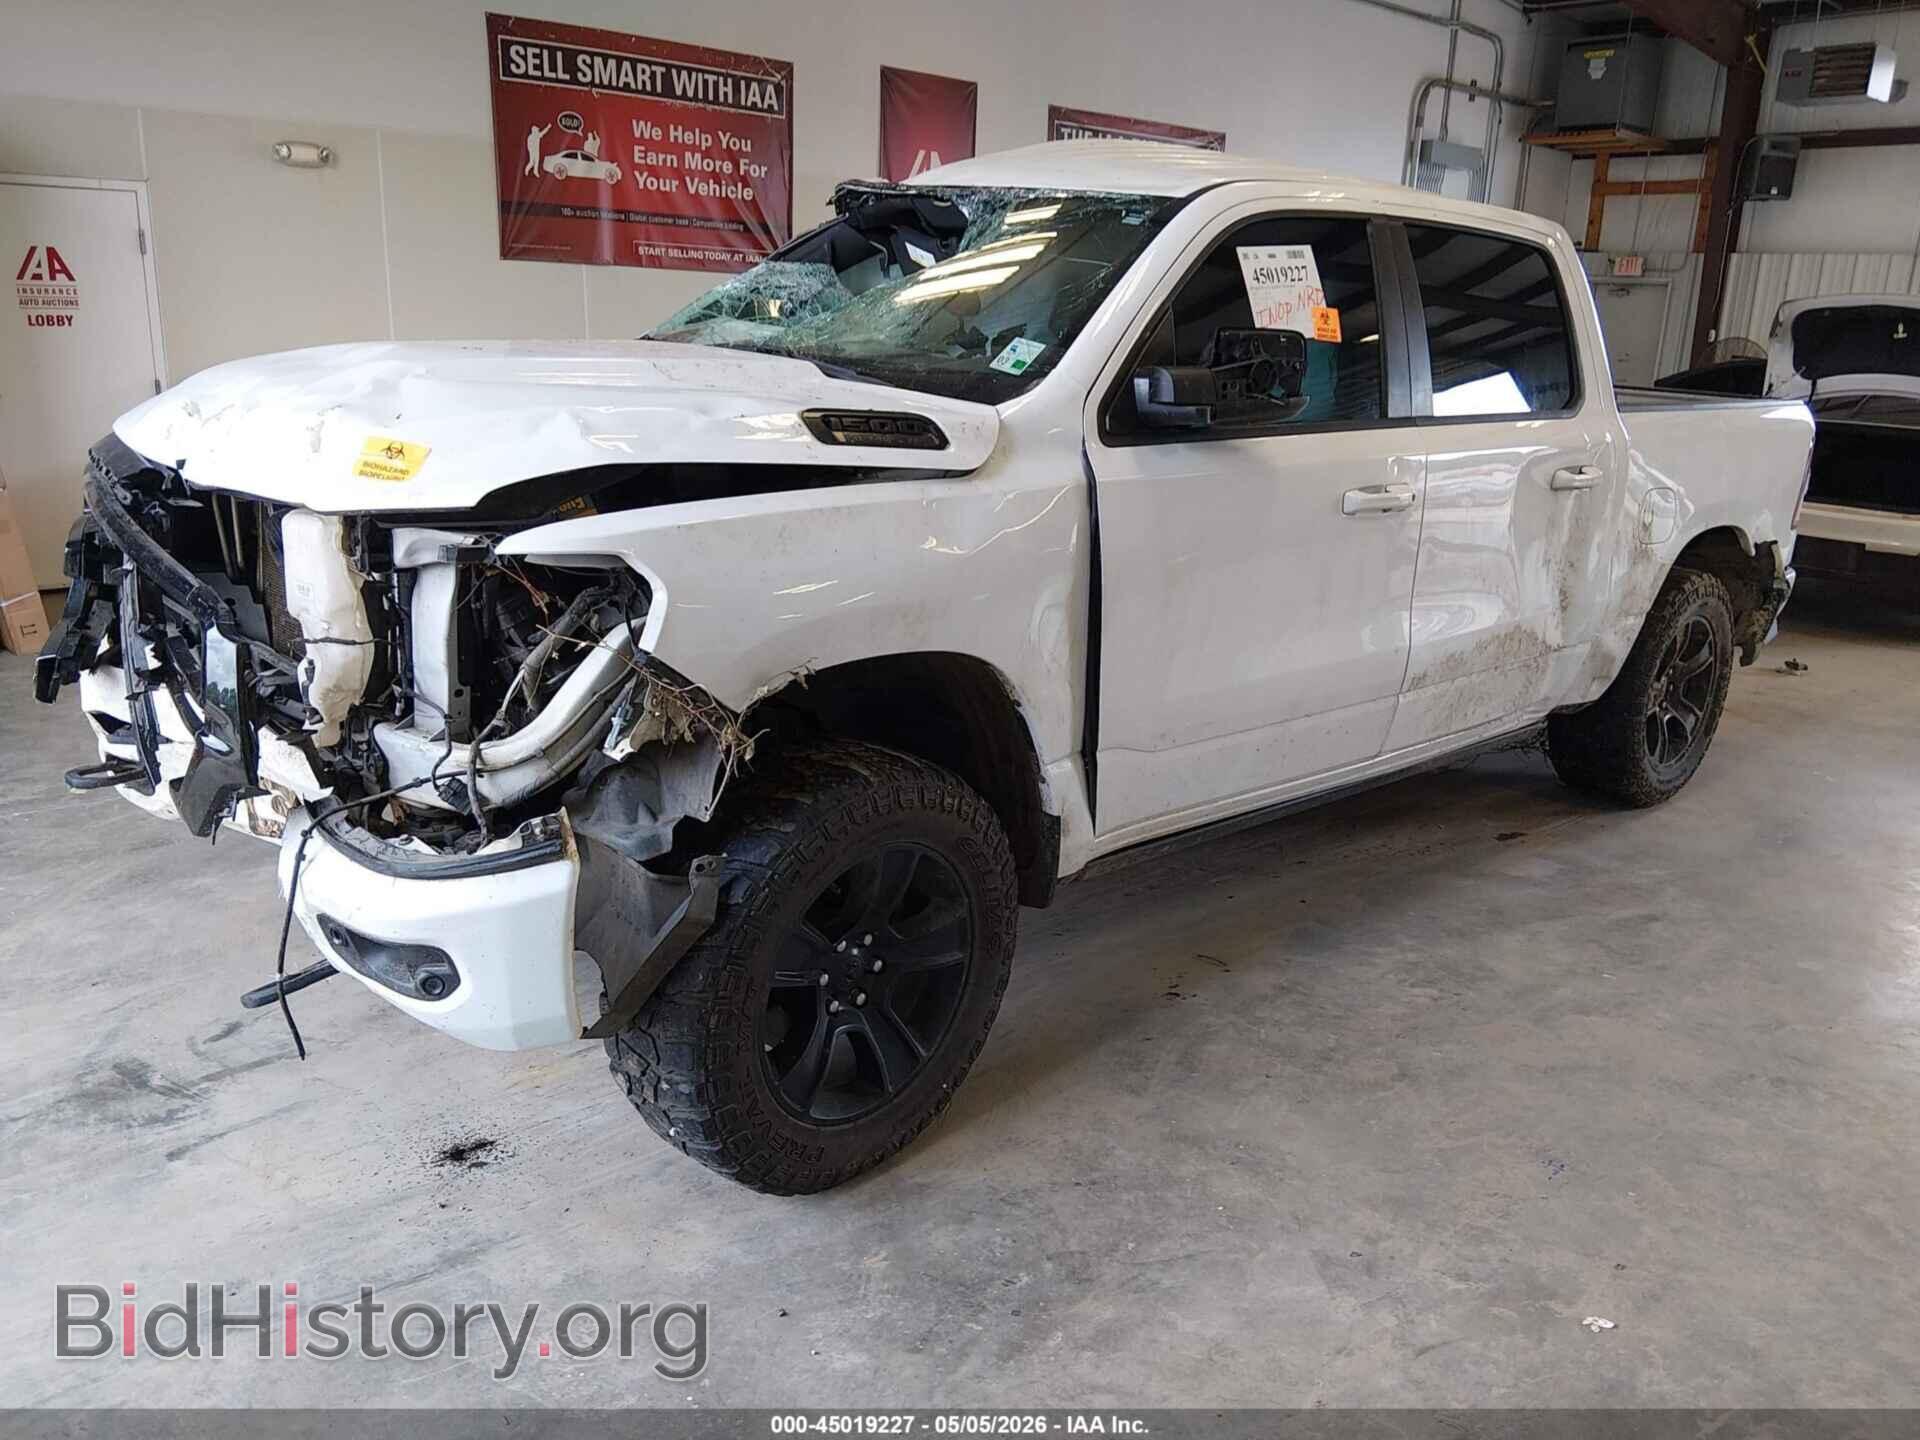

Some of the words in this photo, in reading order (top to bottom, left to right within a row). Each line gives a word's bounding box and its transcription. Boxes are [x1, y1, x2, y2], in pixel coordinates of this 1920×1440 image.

[510, 45, 570, 81] SELL
[576, 53, 666, 94] SMART
[671, 68, 733, 104] WITH
[740, 79, 780, 111] IAA
[632, 119, 662, 140] We
[669, 124, 713, 150] Help
[718, 130, 752, 152] You
[633, 145, 678, 168] Earn
[684, 151, 733, 174] More
[739, 159, 768, 179] For
[633, 170, 679, 192] Your
[685, 176, 753, 201] Vehicle
[638, 245, 666, 257] START
[668, 247, 703, 260] SELLING
[704, 250, 731, 262] TODAY
[733, 253, 744, 263] AT
[1252, 265, 1309, 285] 45019227
[16, 287, 78, 295] INSURANCE
[41, 299, 79, 307] AUCTIONS
[27, 314, 73, 327] LOBBY
